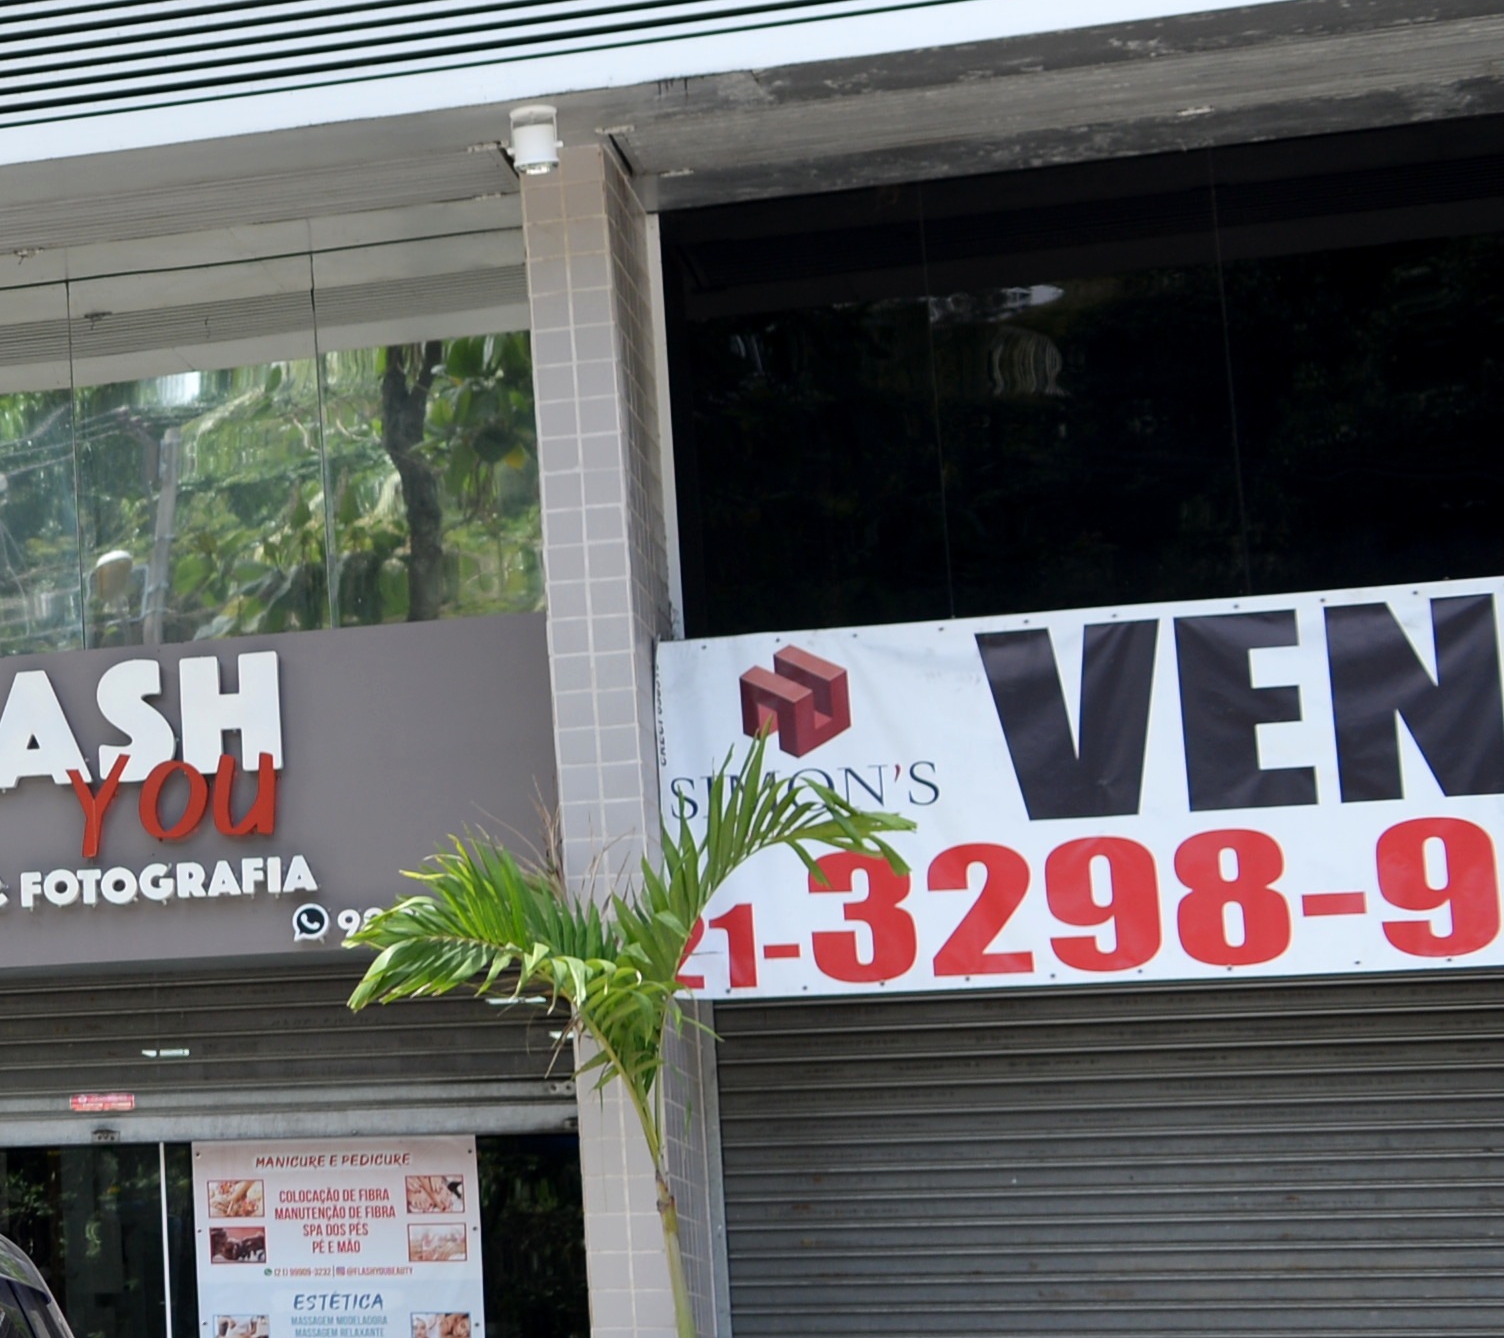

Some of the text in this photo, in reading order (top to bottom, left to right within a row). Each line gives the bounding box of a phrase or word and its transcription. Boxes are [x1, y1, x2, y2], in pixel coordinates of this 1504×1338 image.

[20, 854, 319, 908] FOTOGRAFIA
[255, 1152, 411, 1169] MANICURE E PEDICURE
[279, 1187, 390, 1205] COLOCAÇÃO DE FIBRA
[274, 1205, 396, 1221] MANUTENÇÃO DE FIBRA
[303, 1221, 369, 1237] SPA DOS PÉS
[312, 1238, 361, 1254] PÉ E MÃO
[293, 1291, 384, 1311] ESTÉTICA
[291, 1315, 387, 1325] MASSAGEM MODELADORA
[295, 1327, 384, 1337] MASSAGEM RELAXANTE
